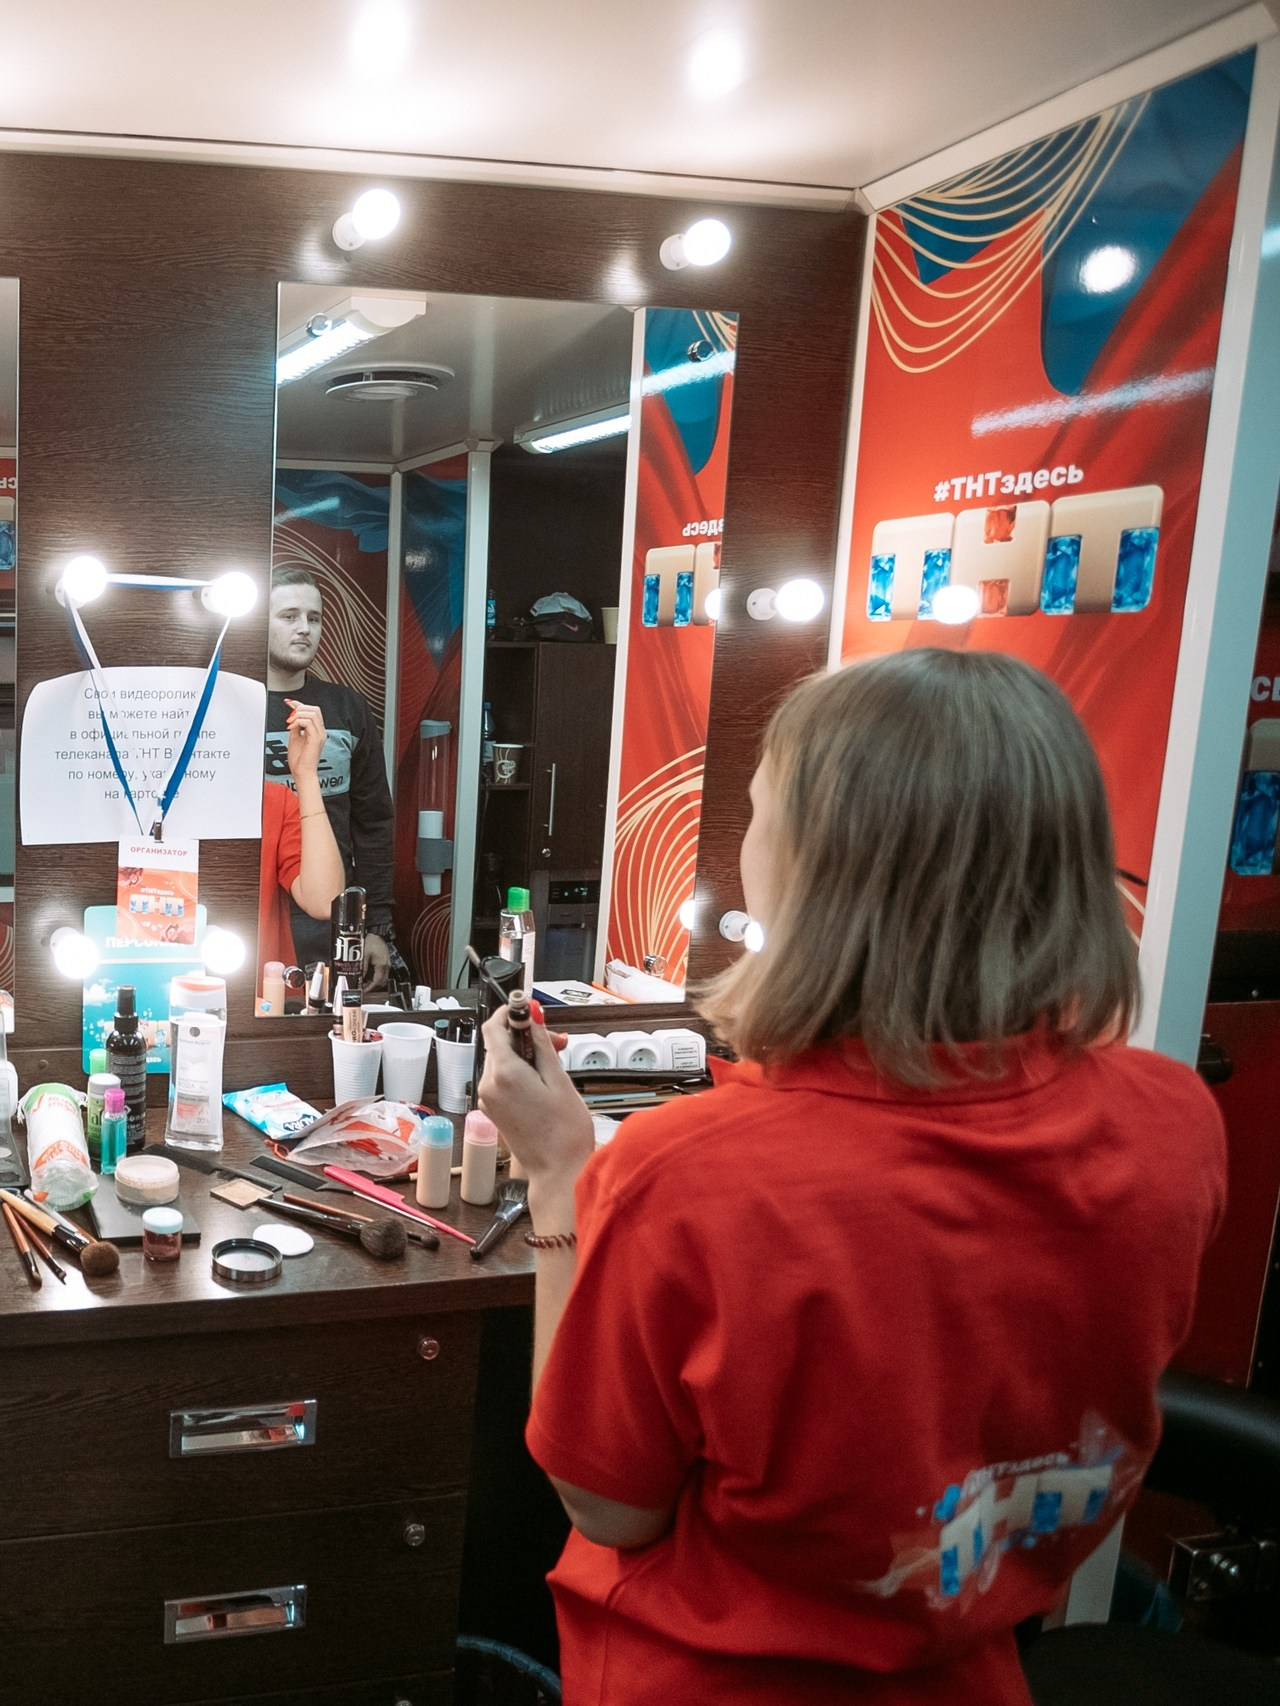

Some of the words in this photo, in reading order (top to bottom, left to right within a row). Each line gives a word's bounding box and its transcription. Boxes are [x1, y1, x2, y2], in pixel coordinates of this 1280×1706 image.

[933, 464, 1084, 503] #ТНТздесь
[866, 484, 1164, 623] ТНТ
[120, 689, 198, 701] видеоролик
[161, 708, 190, 720] найт
[70, 730, 77, 740] в
[133, 747, 160, 759] НТ
[68, 770, 84, 780] по
[104, 790, 120, 800] на
[130, 846, 188, 857] ОРГАНИЗАТОР
